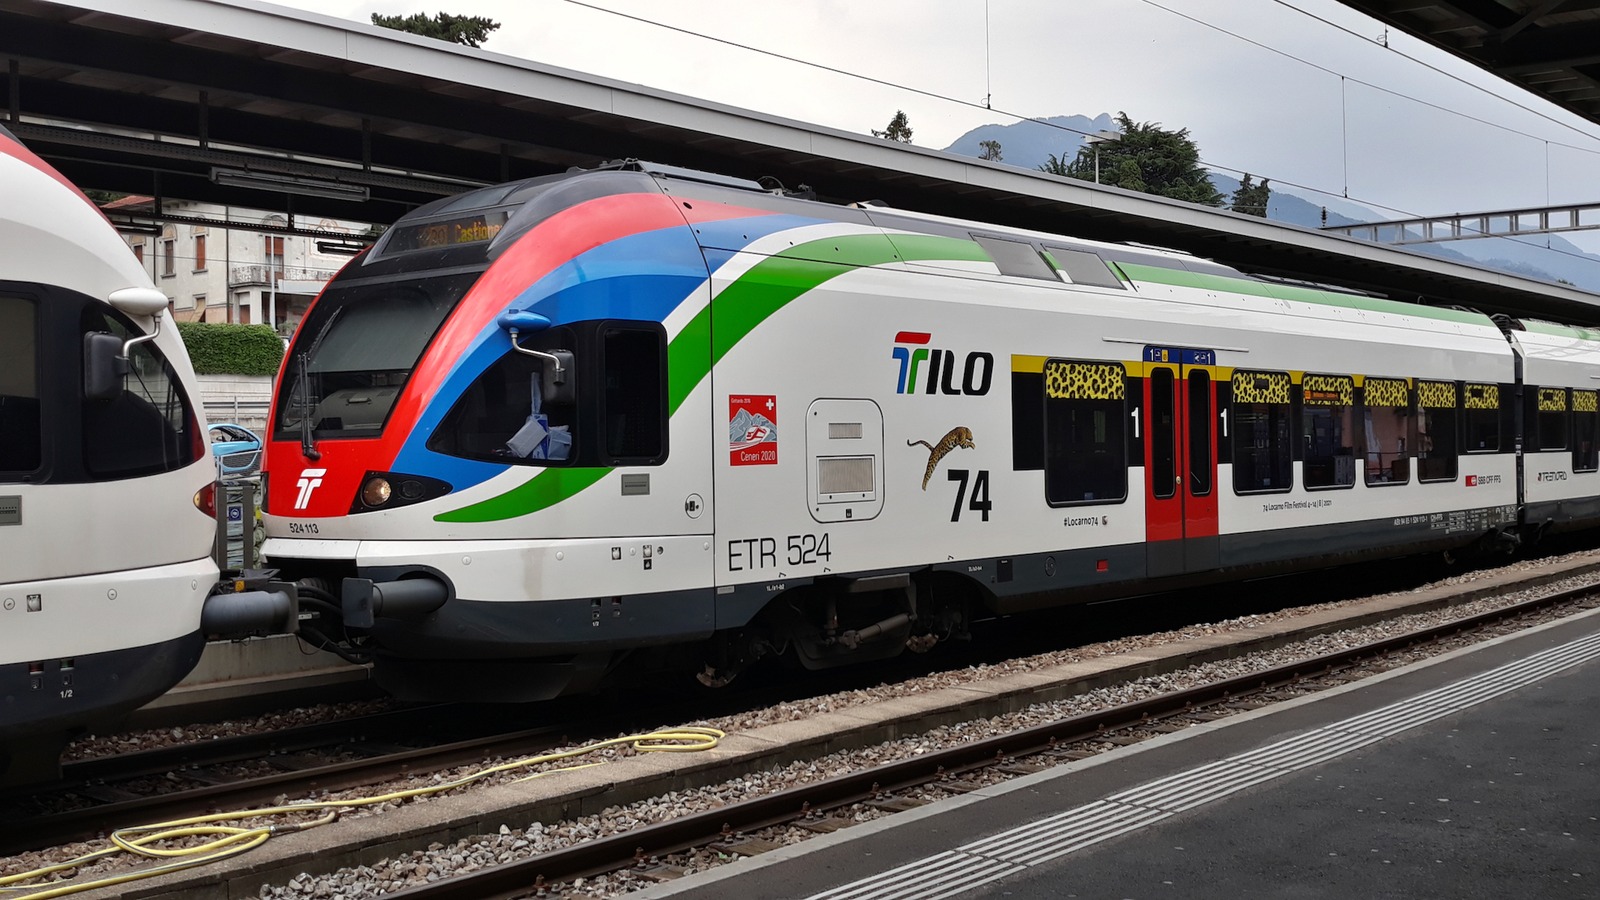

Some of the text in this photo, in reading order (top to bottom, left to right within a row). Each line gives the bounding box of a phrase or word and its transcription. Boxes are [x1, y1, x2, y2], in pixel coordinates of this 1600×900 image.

[892, 331, 994, 396] TILO
[1150, 348, 1154, 361] 1
[1131, 407, 1140, 438] 1
[1220, 408, 1228, 438] 1
[740, 450, 776, 462] Ceneri 2020
[947, 469, 992, 522] 74
[289, 523, 319, 534] 524 113
[1064, 516, 1099, 527] #Locarno74
[728, 532, 831, 571] ETR 524
[60, 689, 73, 699] 1/2
